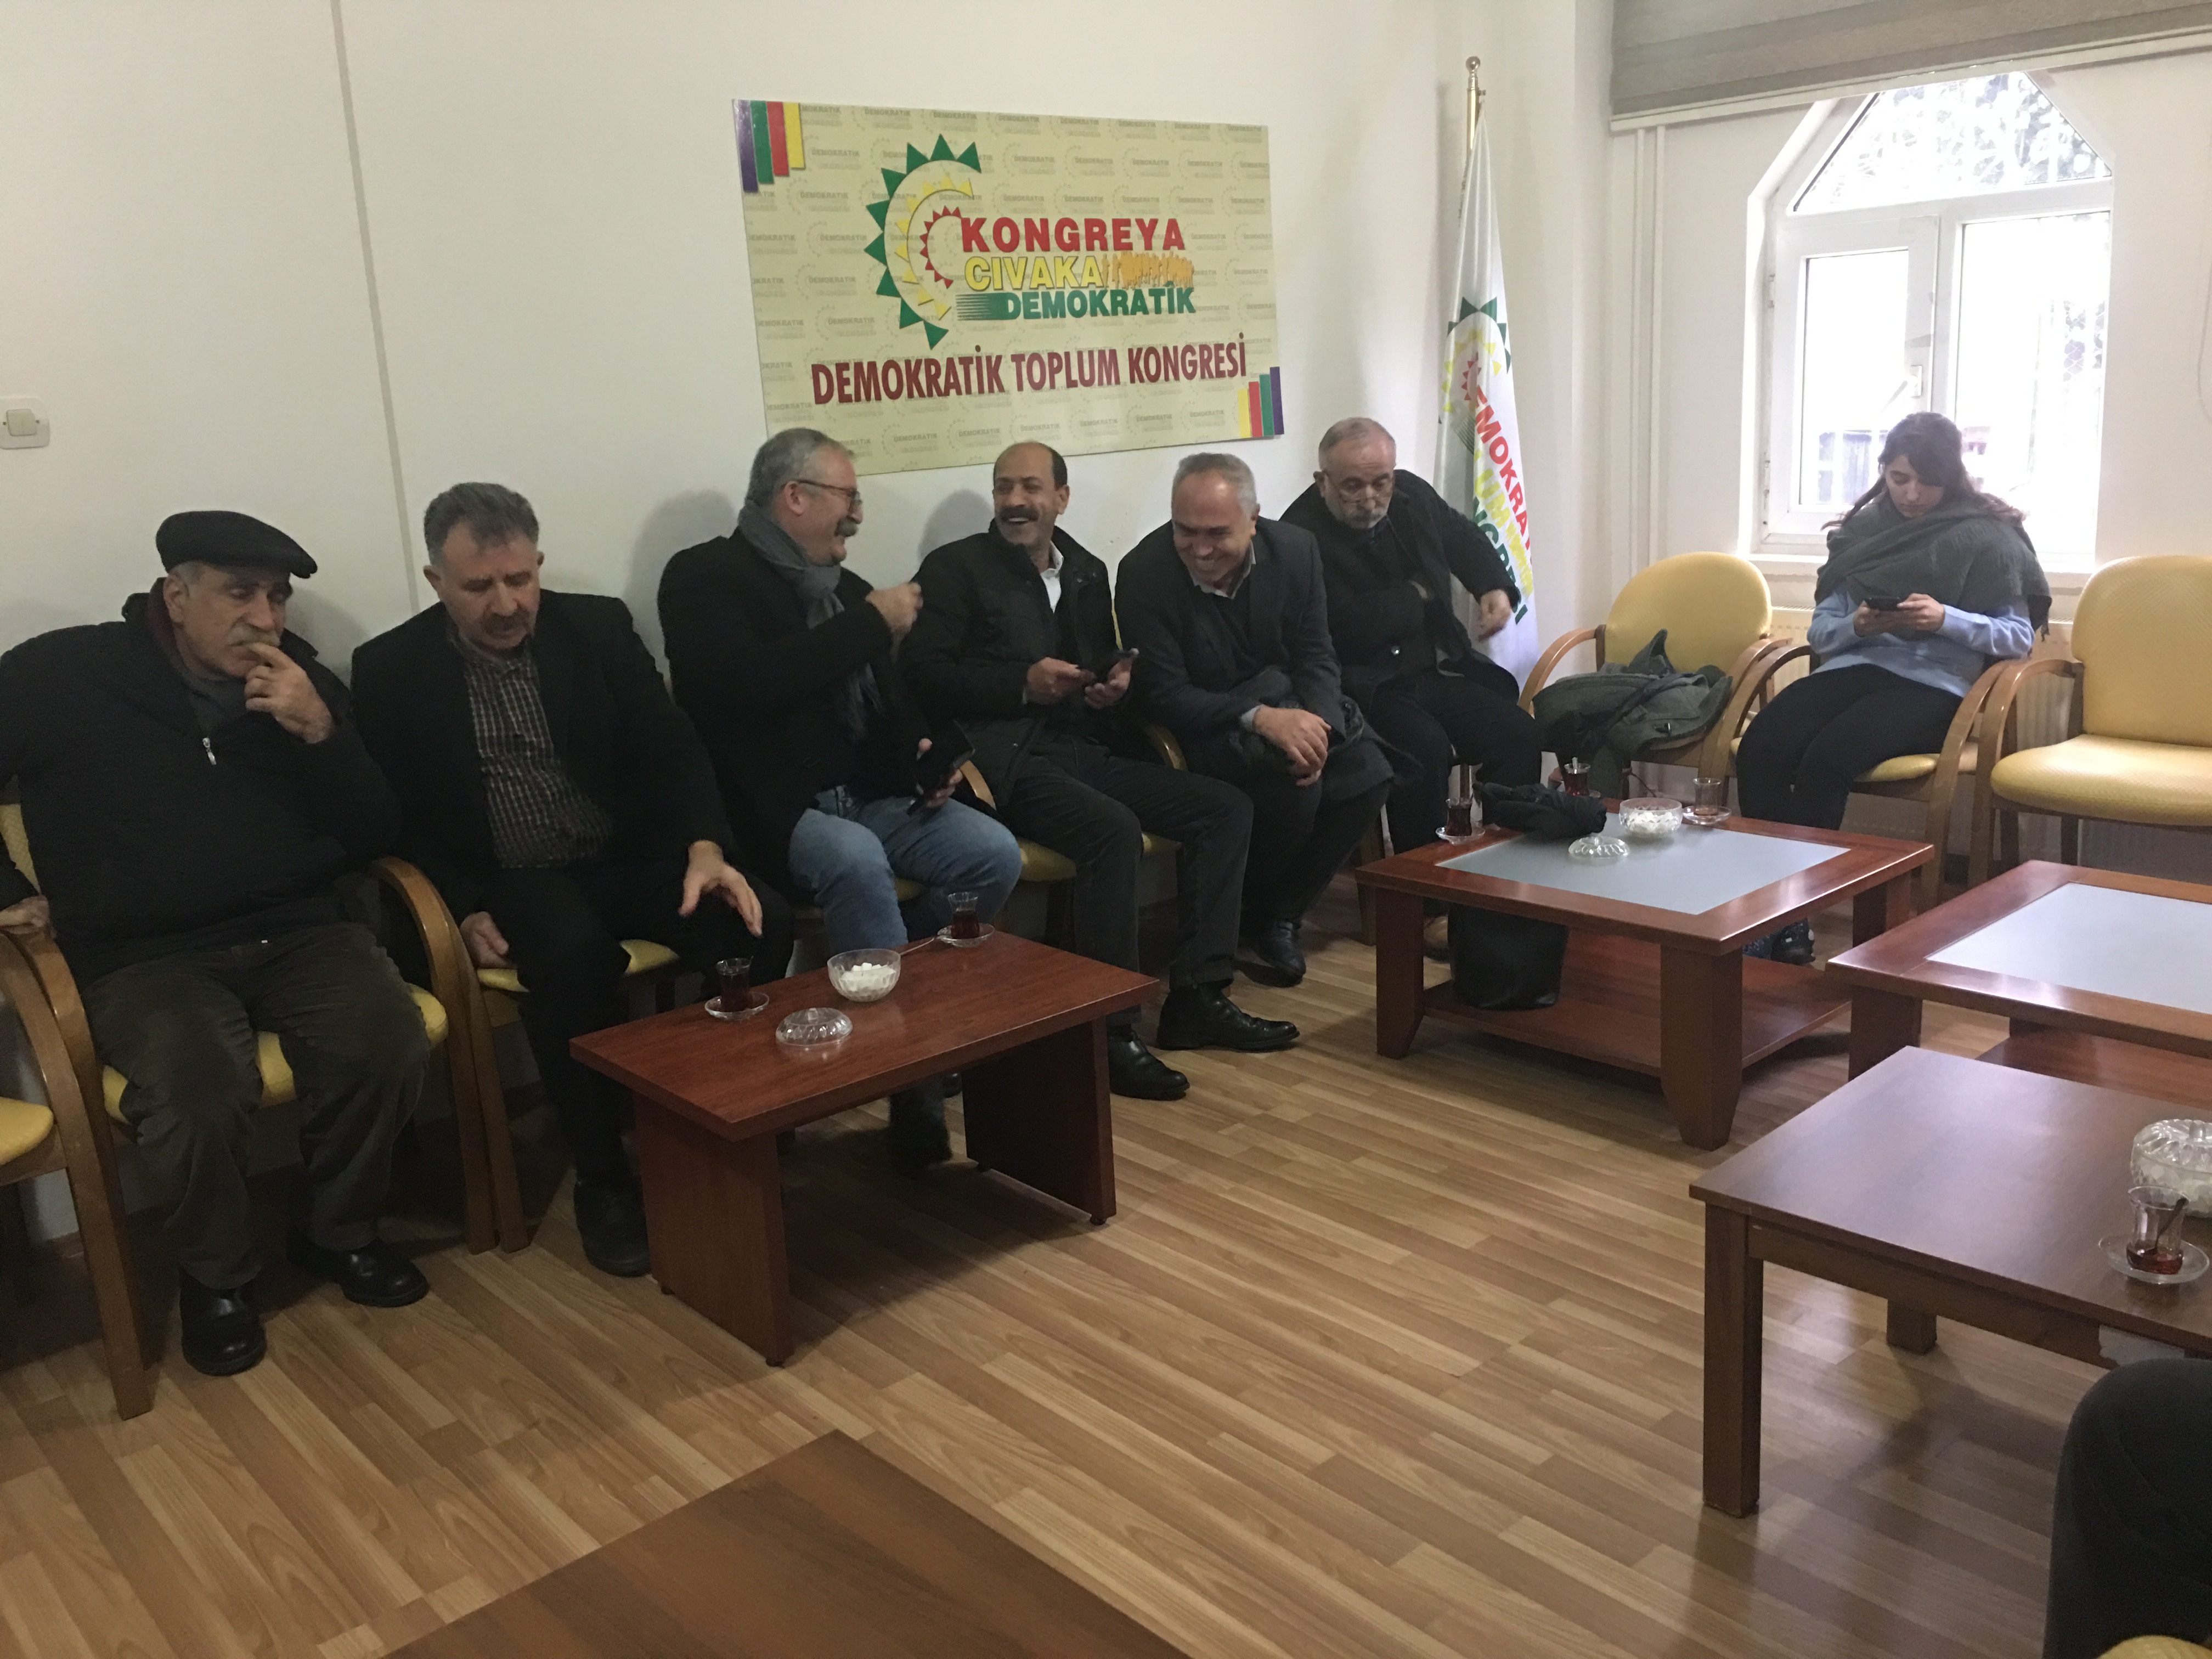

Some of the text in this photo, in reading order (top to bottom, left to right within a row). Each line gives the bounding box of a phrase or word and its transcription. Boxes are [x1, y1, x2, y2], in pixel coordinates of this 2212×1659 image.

[961, 217, 1185, 252] KONGREYA
[964, 255, 1105, 291] CIVAKA
[1011, 348, 1121, 392] TOPLUM
